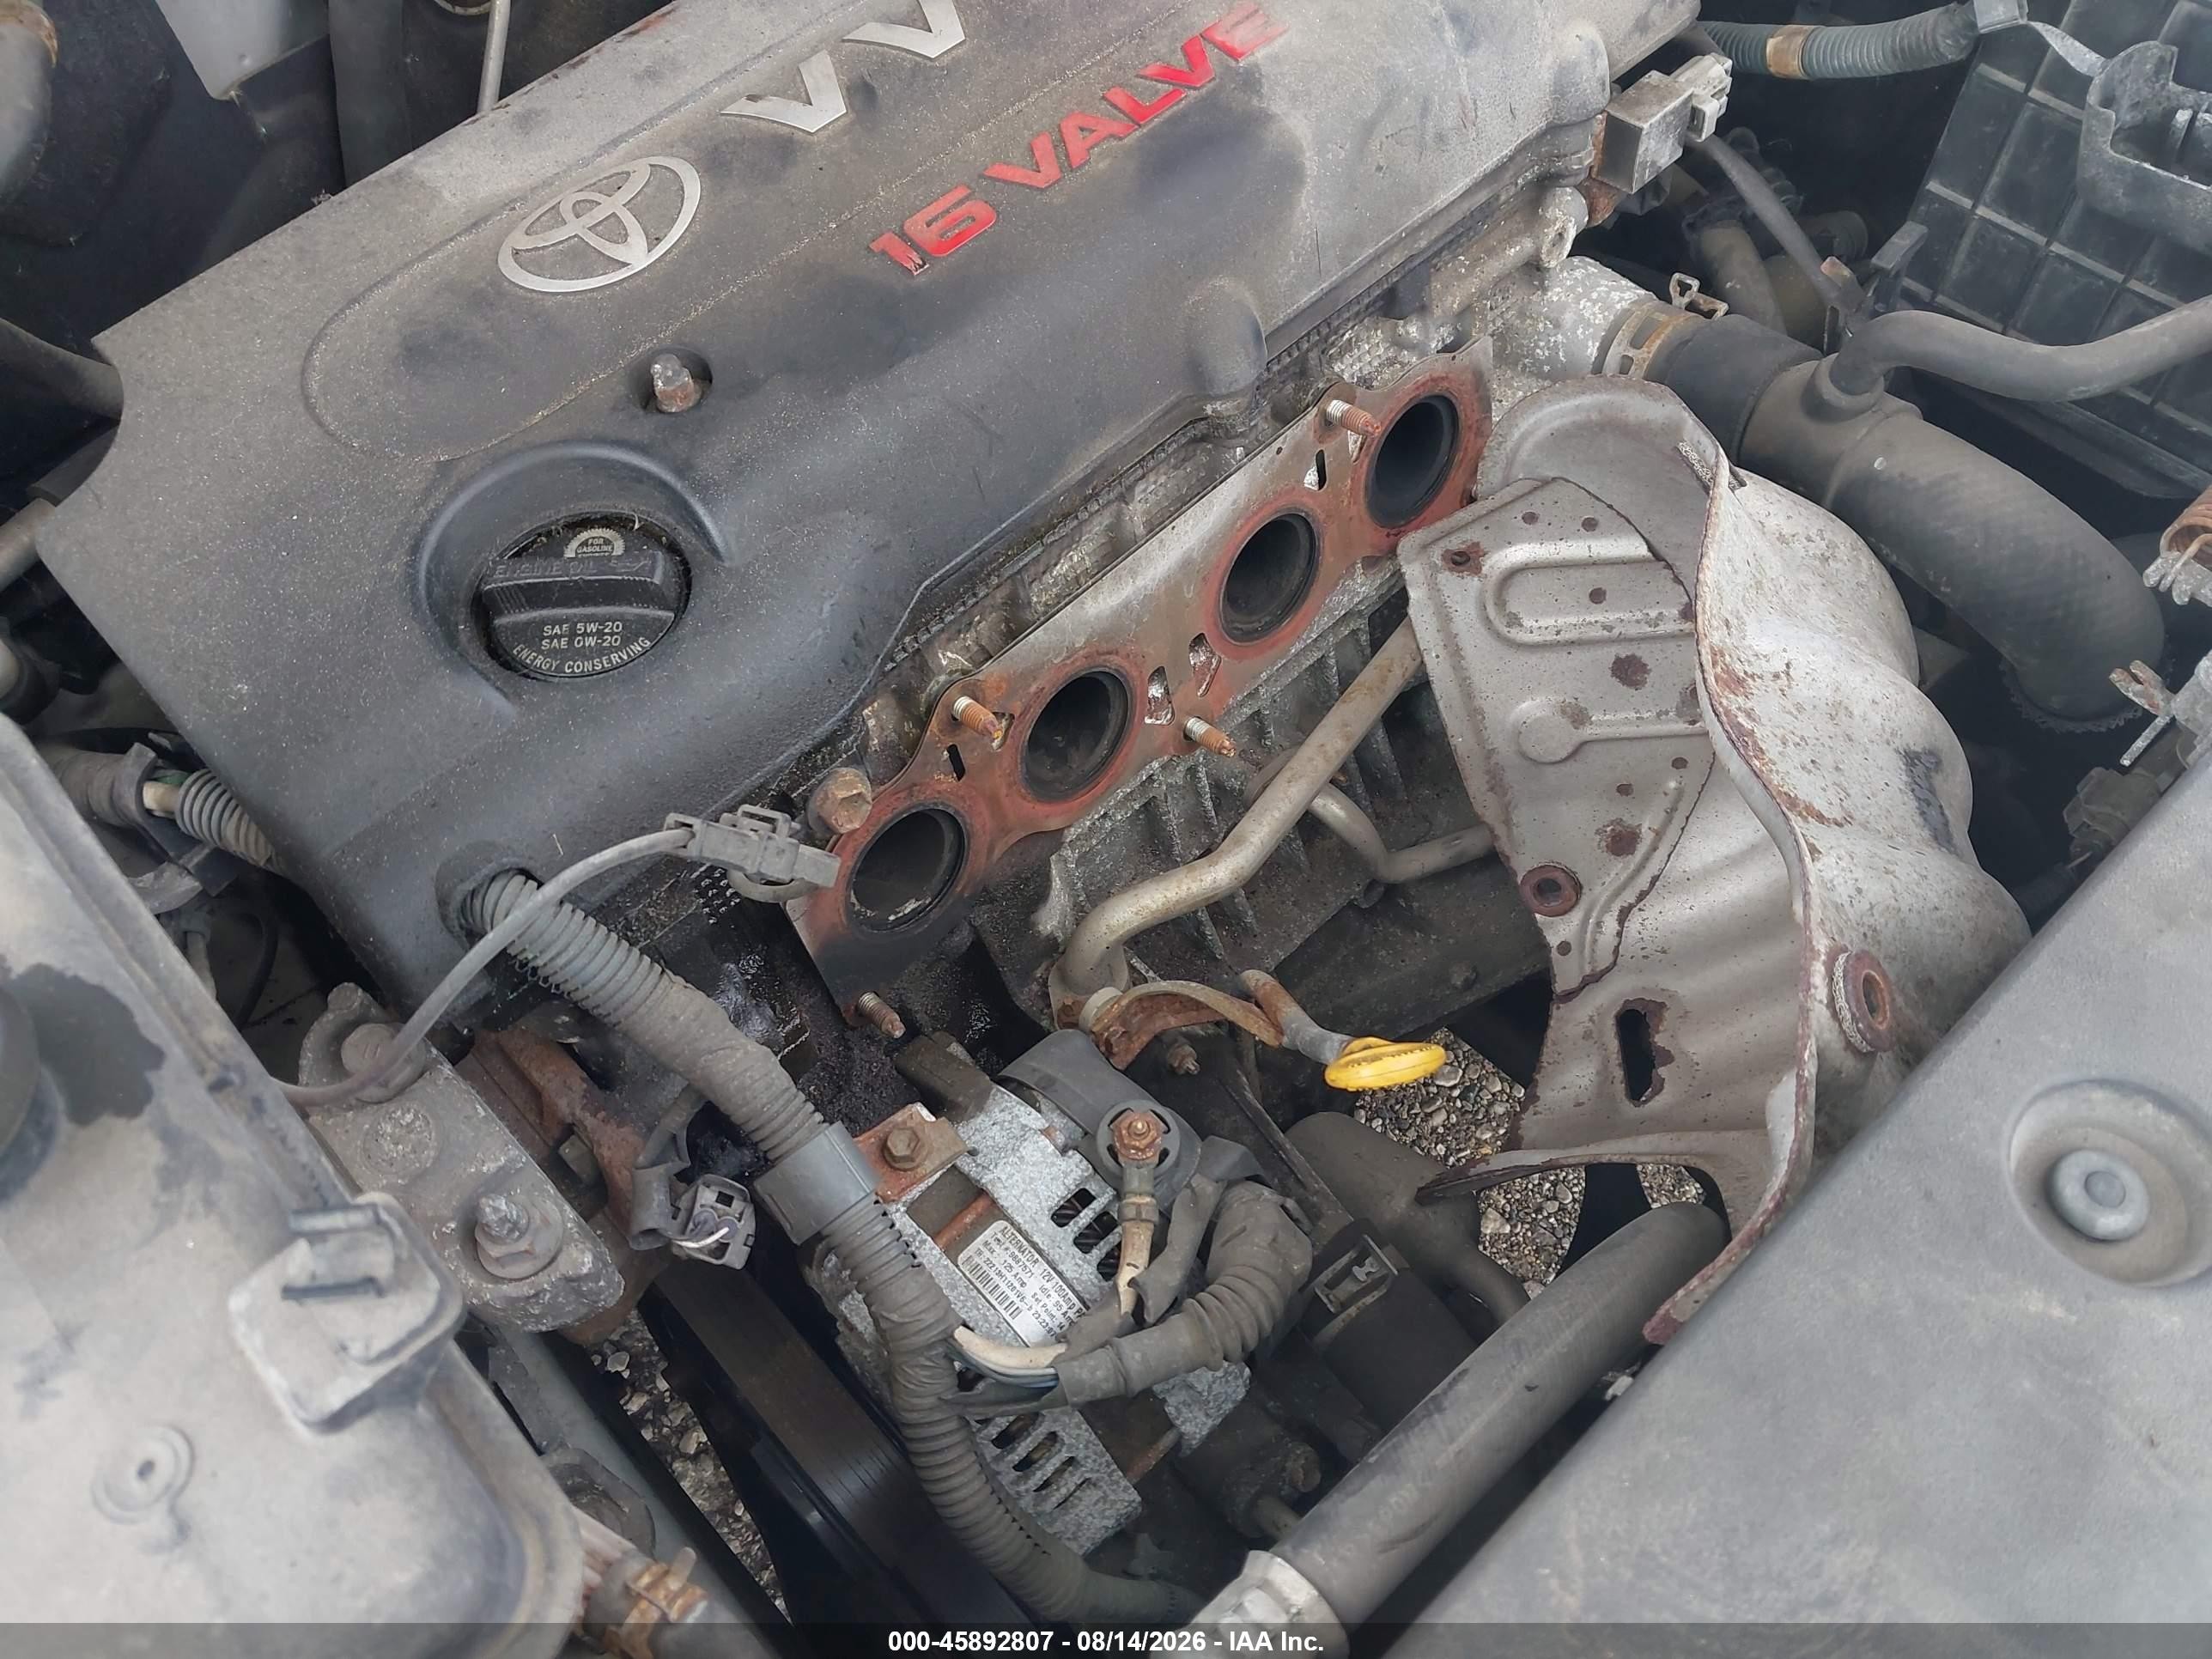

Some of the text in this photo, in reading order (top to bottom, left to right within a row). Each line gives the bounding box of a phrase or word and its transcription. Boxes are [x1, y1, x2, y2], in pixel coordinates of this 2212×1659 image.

[869, 3, 1290, 276] 16 VALVE
[541, 635, 621, 650] SAE 0W-20
[544, 622, 623, 636] SAE 5W-20
[513, 636, 651, 673] ENERGY CONSERVING
[999, 1225, 1040, 1267] ALTERNATOR
[1001, 1260, 1015, 1273] 125
[1012, 1272, 1028, 1288] Amp
